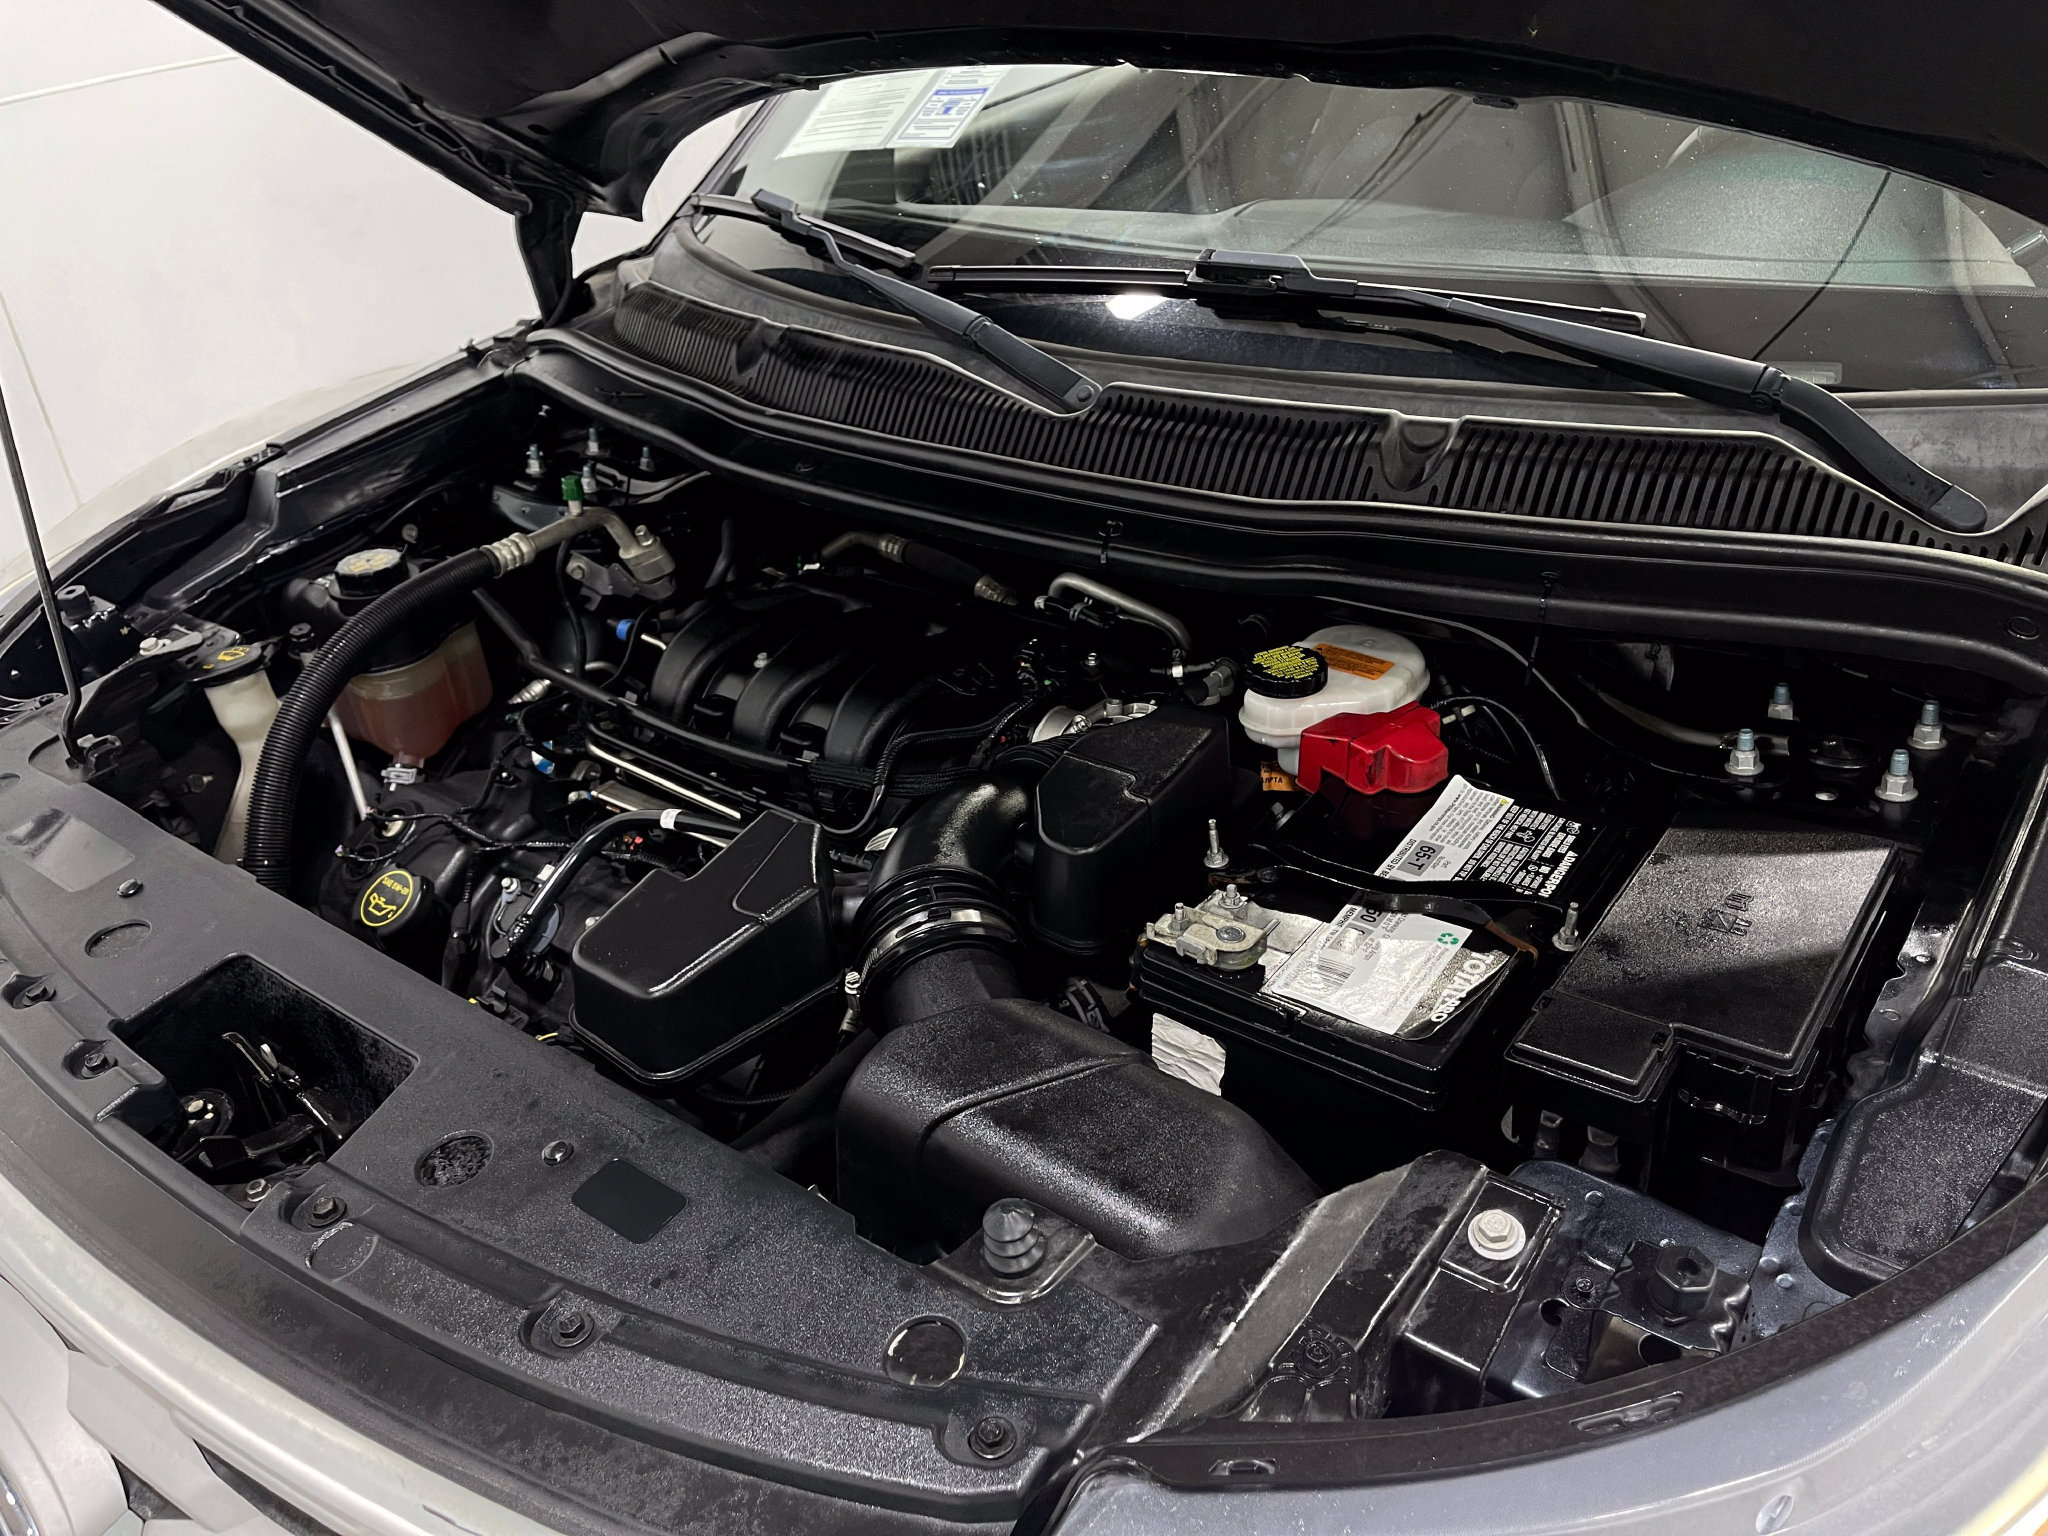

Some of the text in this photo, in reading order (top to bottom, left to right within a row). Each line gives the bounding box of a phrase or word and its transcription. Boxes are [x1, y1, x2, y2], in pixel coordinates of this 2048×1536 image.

[1391, 838, 1417, 865] DISTRIBUTED
[1407, 845, 1437, 871] 65-T
[1386, 864, 1396, 872] BY
